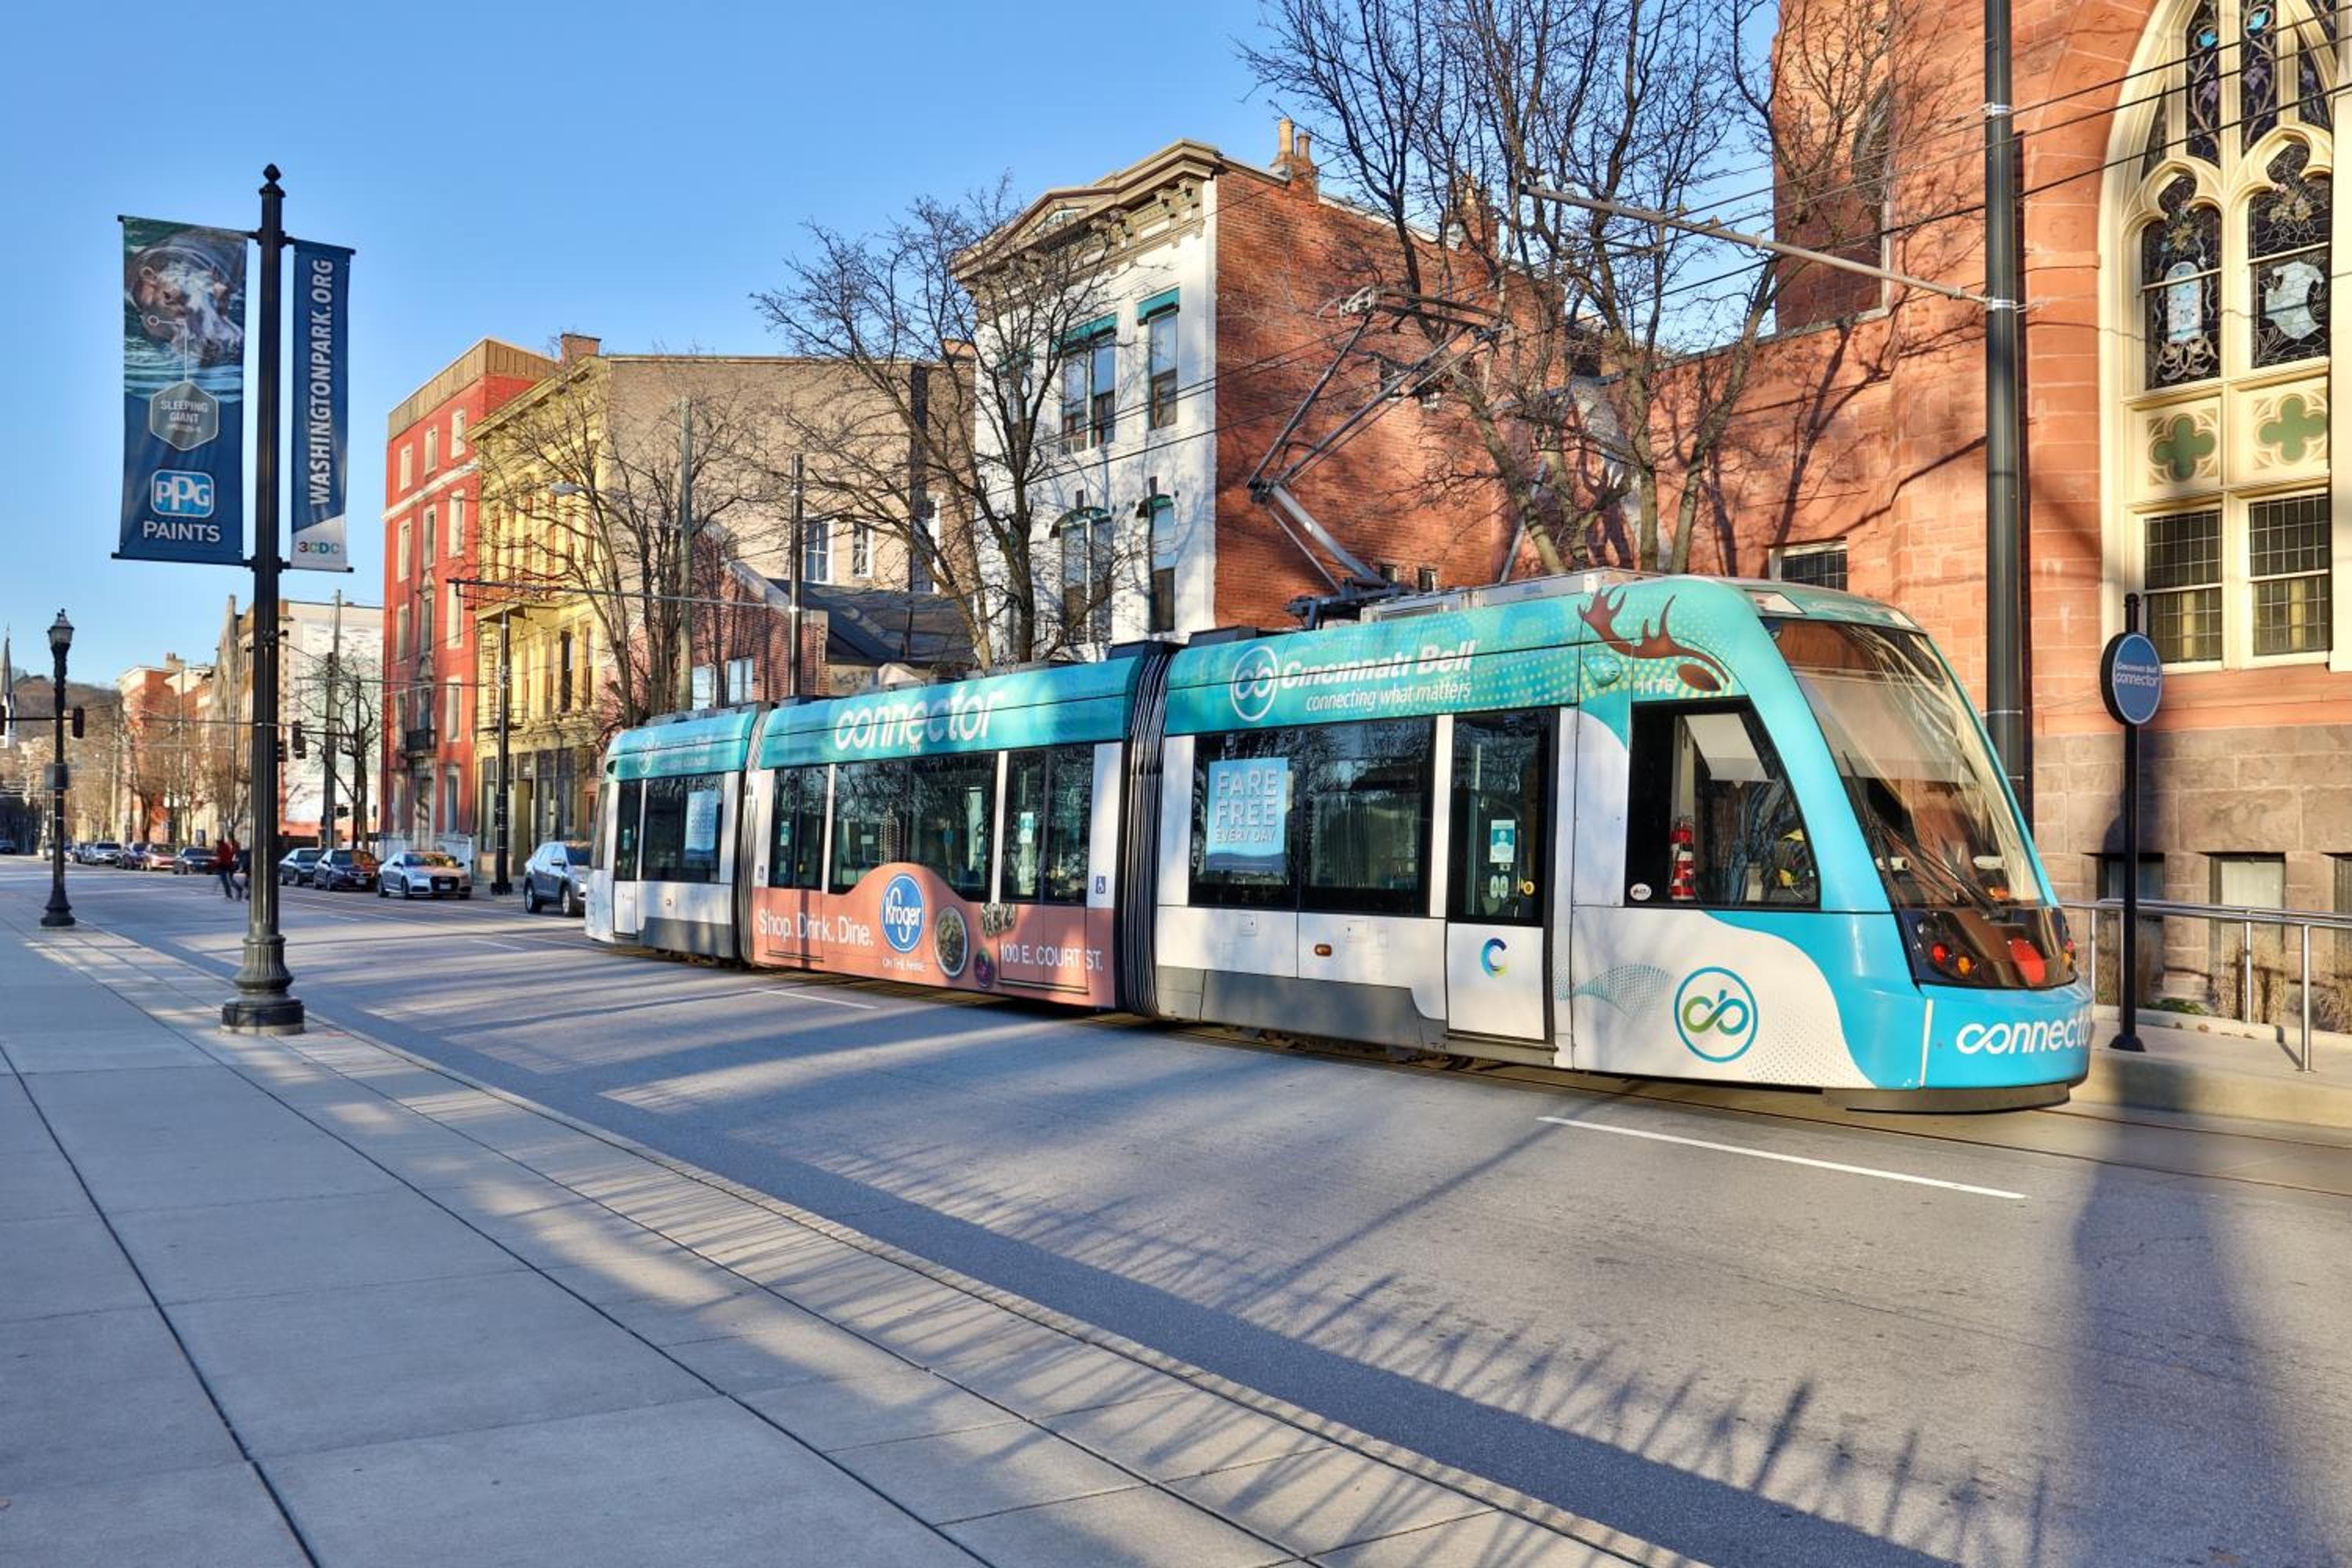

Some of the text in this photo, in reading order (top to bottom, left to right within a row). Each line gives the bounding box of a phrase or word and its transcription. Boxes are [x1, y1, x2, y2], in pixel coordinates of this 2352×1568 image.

[309, 260, 333, 505] WASHINGTONPARK.ORG
[160, 400, 209, 413] SLEEPING
[169, 412, 199, 424] GIANT
[155, 476, 210, 510] PPG
[143, 521, 220, 543] PAINTS
[298, 540, 339, 554] 3CDC
[1279, 639, 1480, 689] Cincinnati Bell
[1306, 678, 1471, 712] connecting what matters
[835, 686, 1004, 750] connector
[1217, 768, 1279, 798] FARE
[1215, 797, 1278, 828] FREE
[1215, 828, 1276, 843] EVERY DAY
[758, 907, 874, 947] Shop. Drink. Dine.
[884, 886, 921, 944] Kroger
[1000, 942, 1104, 971] 100 E. COURT ST.
[1956, 1009, 2091, 1054] connecto
